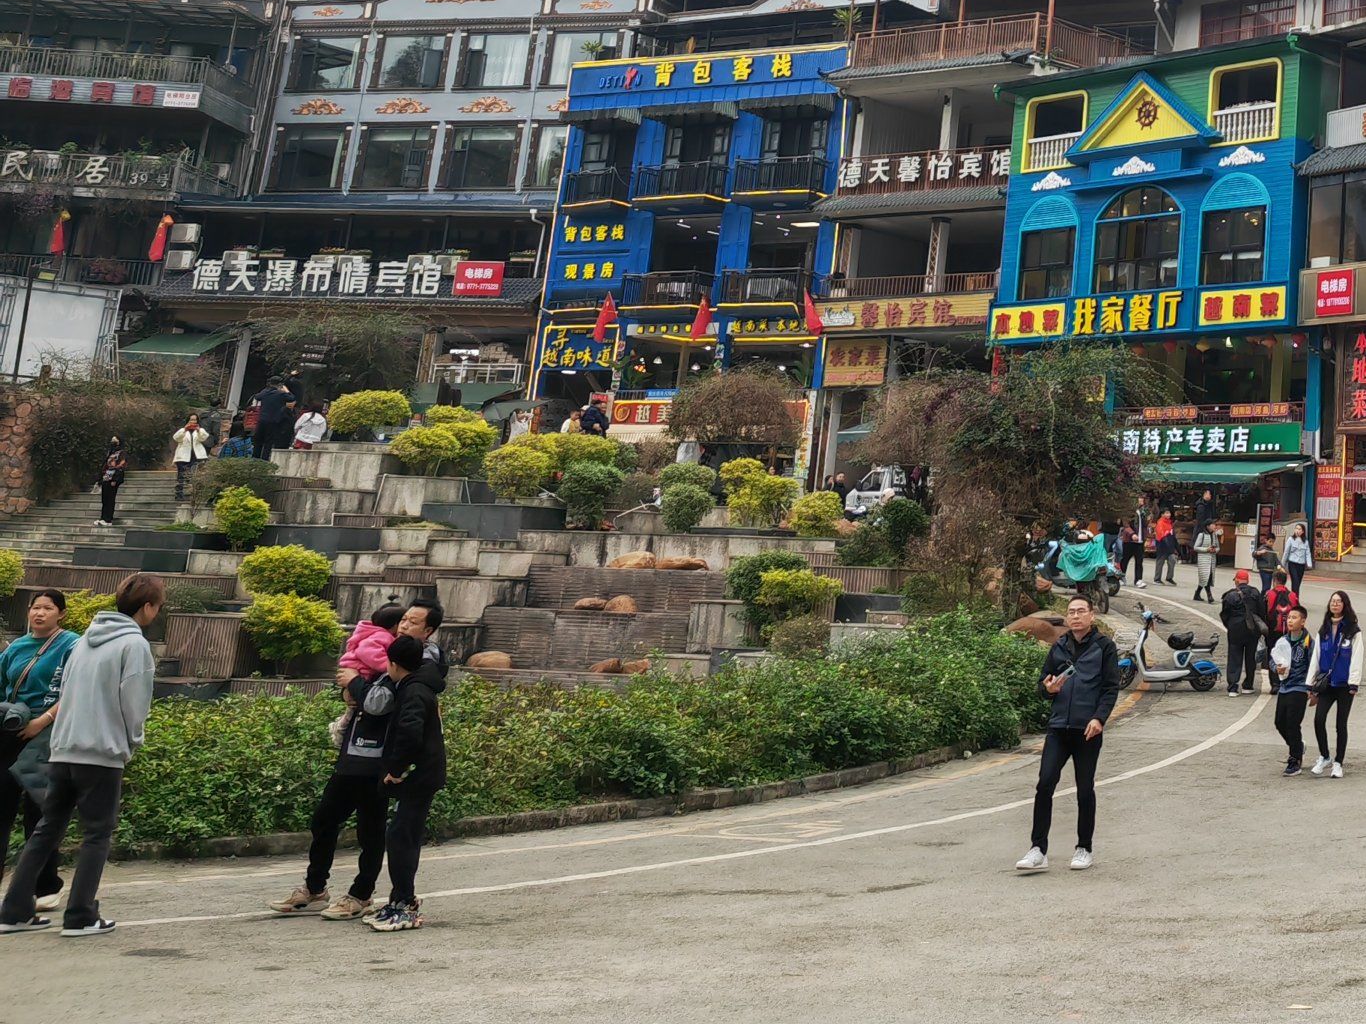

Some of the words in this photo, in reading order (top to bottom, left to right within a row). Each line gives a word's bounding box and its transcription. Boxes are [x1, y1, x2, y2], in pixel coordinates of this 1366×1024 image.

[655, 53, 793, 88] 背包客栈
[838, 148, 1011, 188] 德天馨怡宾馆
[565, 224, 625, 242] 背包客栈
[191, 258, 442, 296] 德天瀑布情宾馆
[464, 267, 493, 279] 电梯房
[564, 261, 615, 279] 观景房
[1320, 278, 1348, 293] 电梯房
[1071, 290, 1184, 336] 我家餐厅
[1114, 426, 1250, 456] 南特产专卖店
